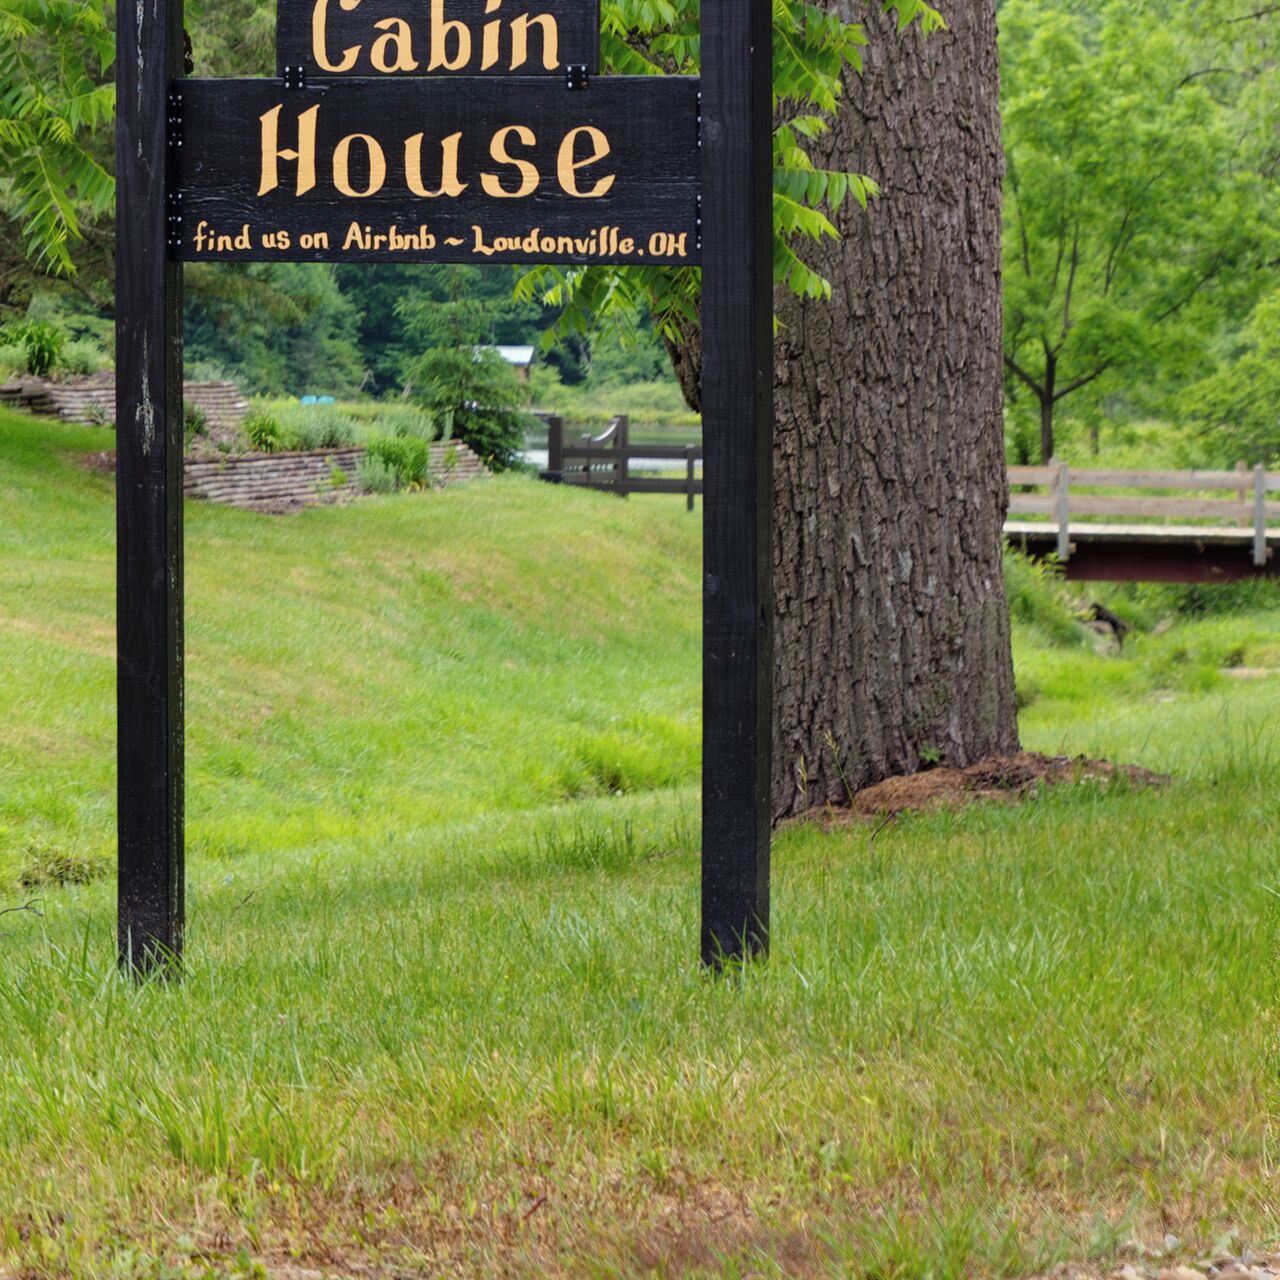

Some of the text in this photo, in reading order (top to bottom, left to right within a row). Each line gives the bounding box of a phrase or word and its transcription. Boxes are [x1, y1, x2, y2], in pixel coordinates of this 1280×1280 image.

[256, 103, 616, 198] House
[192, 220, 252, 252] find
[261, 230, 291, 250] us
[299, 231, 329, 250] on
[342, 221, 436, 252] Airbnb
[648, 231, 688, 257] OH
